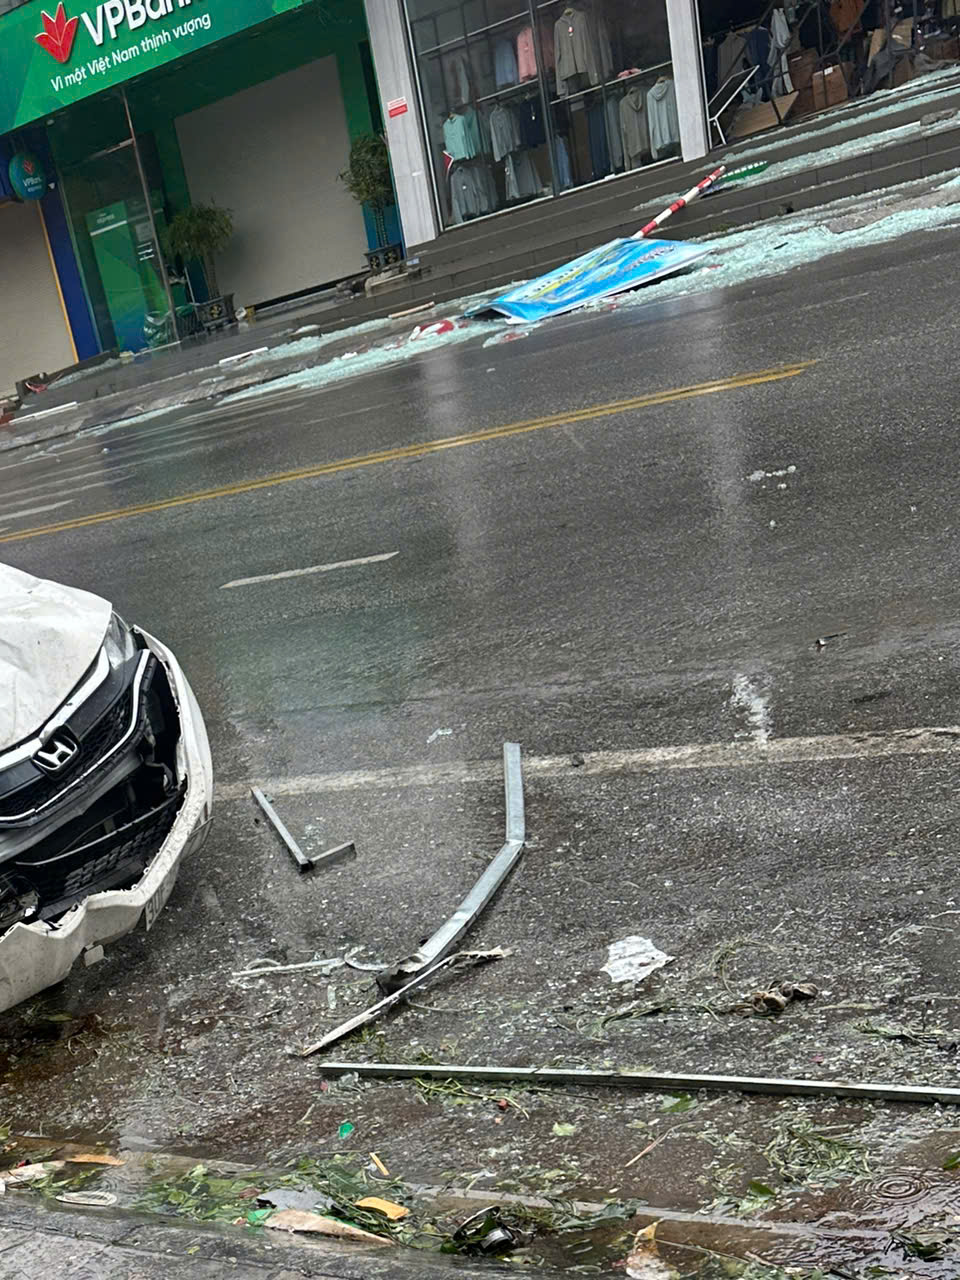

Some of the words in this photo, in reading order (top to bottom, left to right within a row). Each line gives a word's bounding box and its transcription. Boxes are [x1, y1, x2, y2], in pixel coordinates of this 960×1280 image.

[50, 75, 64, 92] Vì
[64, 65, 87, 85] một
[87, 57, 111, 75] Việt
[111, 45, 140, 66] Nam
[140, 29, 172, 52] thịnh
[172, 13, 212, 37] vượng
